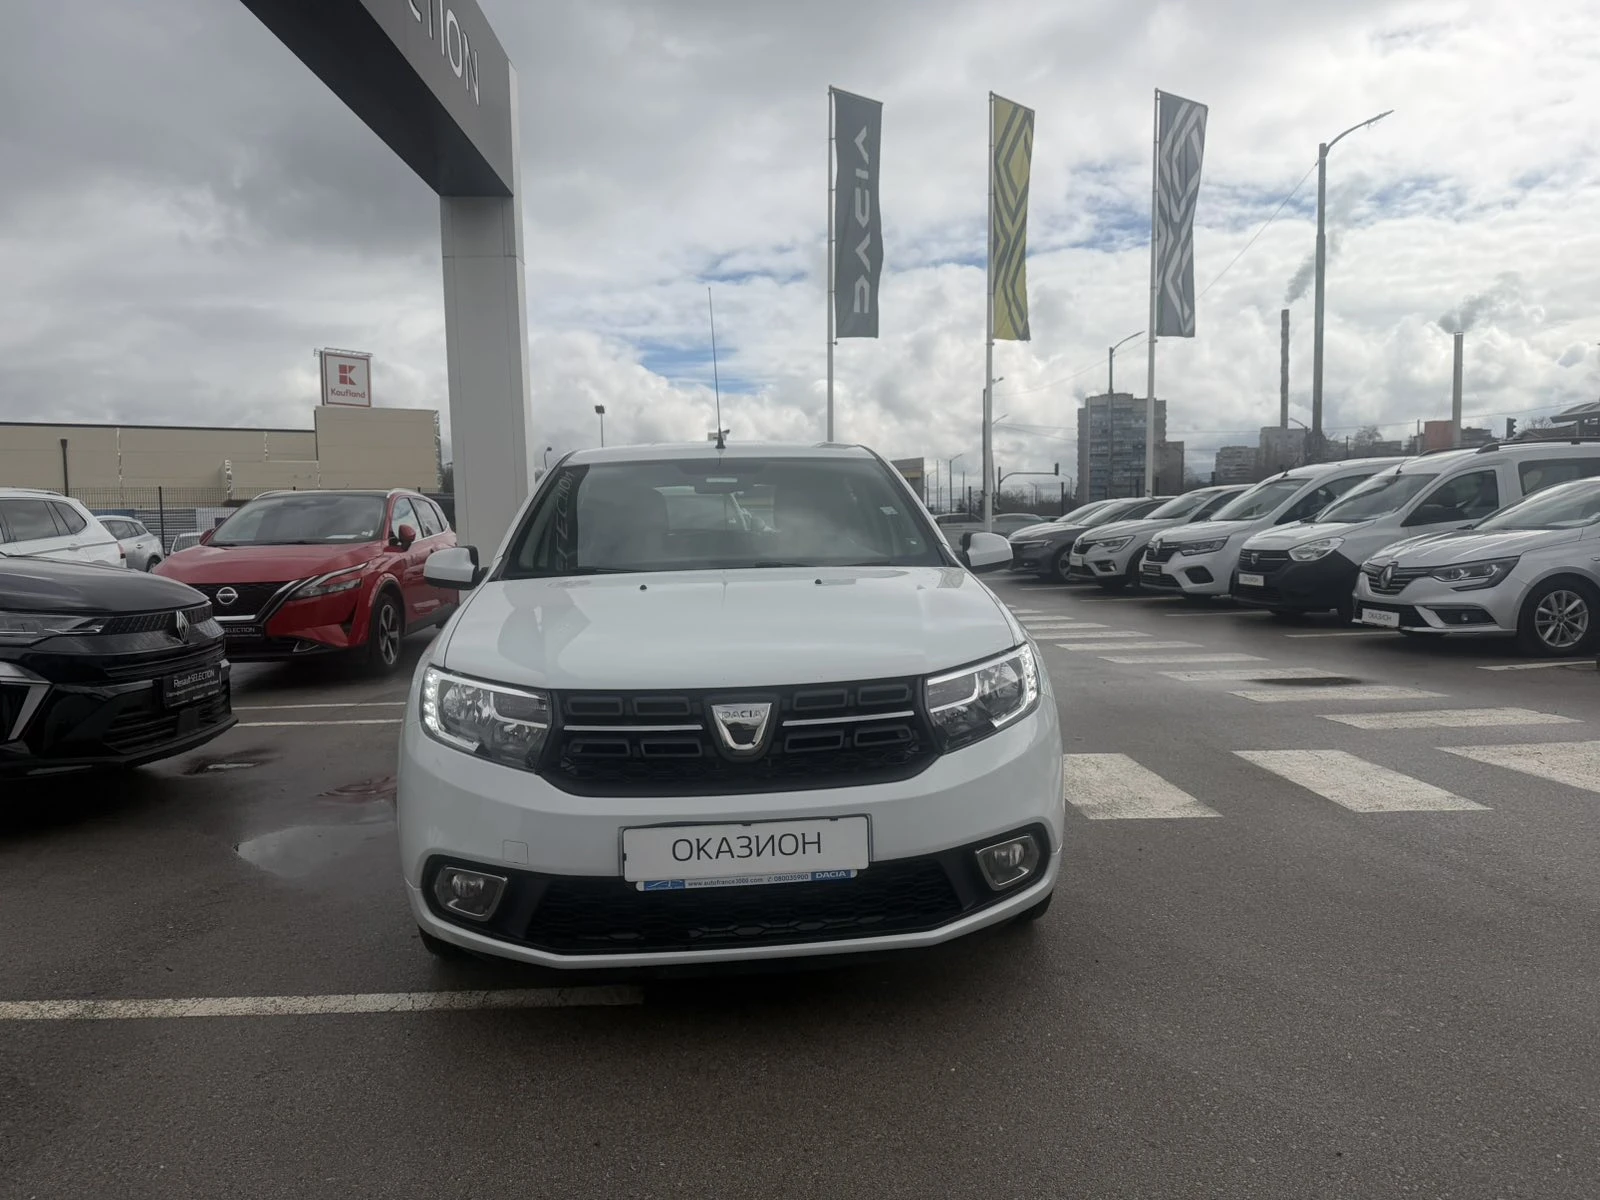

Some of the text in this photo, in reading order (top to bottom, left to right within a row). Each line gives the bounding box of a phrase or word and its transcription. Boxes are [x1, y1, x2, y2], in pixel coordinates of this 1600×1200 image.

[330, 387, 366, 399] Kaufland
[721, 709, 763, 720] DACIA
[671, 831, 822, 862] ОКАЗИОН
[815, 870, 847, 879] DACIA
